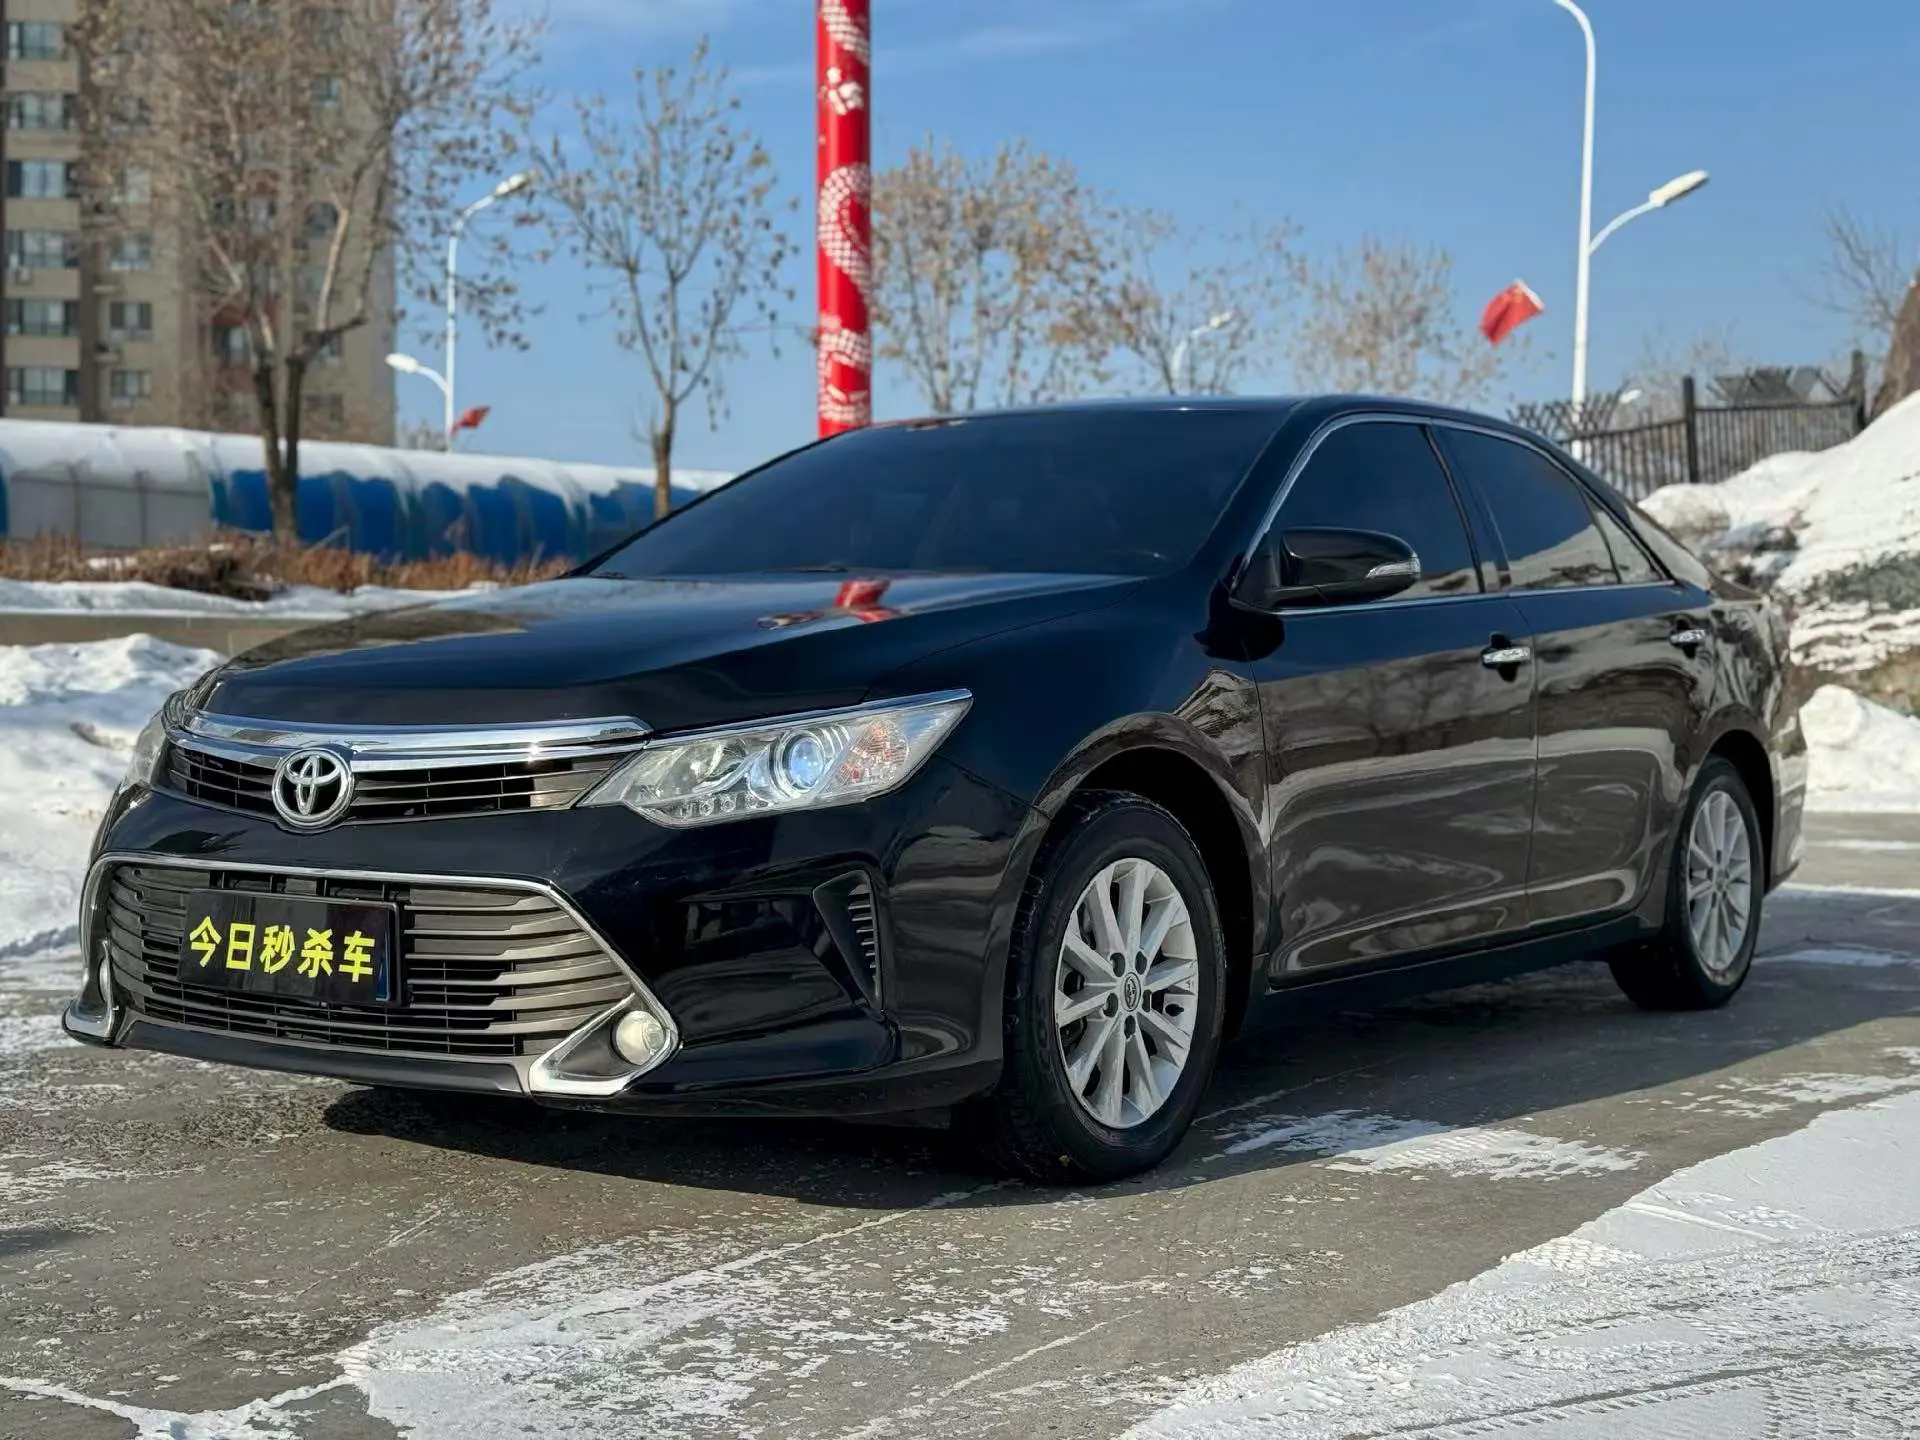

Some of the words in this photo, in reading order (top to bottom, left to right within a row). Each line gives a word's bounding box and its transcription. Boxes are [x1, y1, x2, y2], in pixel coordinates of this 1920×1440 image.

[189, 916, 376, 983] 今日秒杀车
